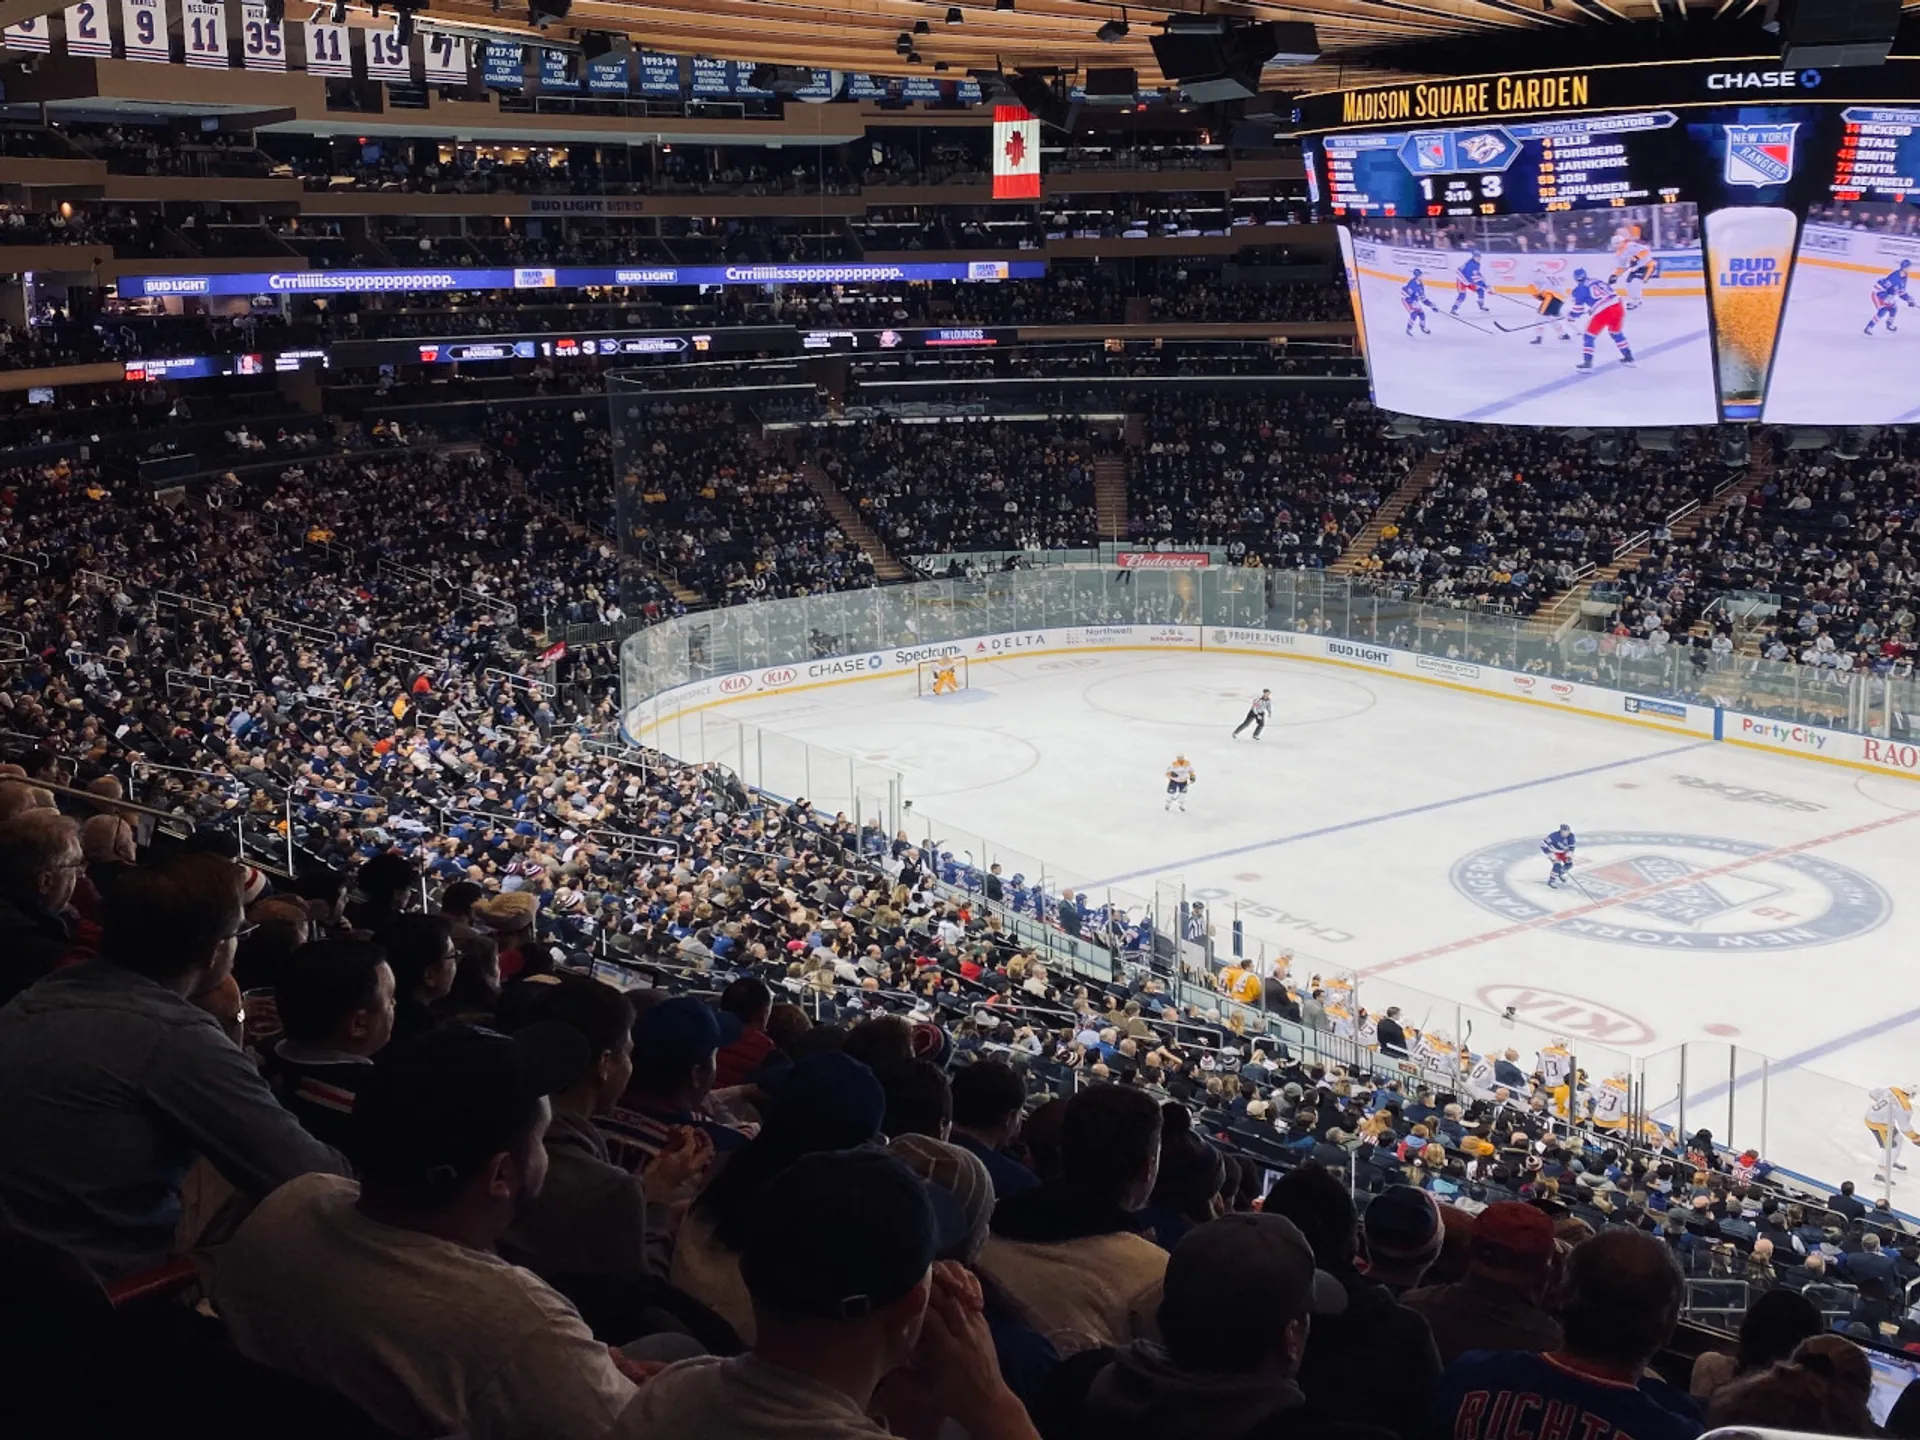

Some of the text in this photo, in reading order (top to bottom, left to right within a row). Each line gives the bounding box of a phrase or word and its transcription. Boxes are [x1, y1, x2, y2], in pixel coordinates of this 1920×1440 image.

[77, 3, 97, 38] 2
[137, 10, 154, 44] 9
[191, 17, 219, 52] 11
[246, 21, 281, 56] 35
[314, 29, 341, 60] 11
[372, 32, 403, 65] 19
[642, 56, 677, 66] 1993-94
[485, 74, 523, 83] CHAMPIONS
[590, 80, 628, 88] CHAMPIONS
[1707, 71, 1796, 89] CHASE
[642, 82, 679, 91] CHAMPIONS
[693, 84, 729, 92] CHAMPIONS
[1343, 75, 1588, 122] MADISON SQUARE GARDEN
[1872, 112, 1893, 121] NEW
[1532, 117, 1654, 135] NASHVILLE PREDATORS
[1542, 134, 1591, 147] 4 ELLIS
[1732, 132, 1789, 143] NEW YORK
[1858, 137, 1899, 148] STAAL
[1554, 144, 1625, 159] FORSBERG
[1856, 150, 1896, 161] SMITH
[1555, 157, 1629, 171] JARNKROK
[1740, 147, 1786, 179] RANGERS
[1854, 163, 1897, 173] CHYTIL
[1557, 172, 1587, 184] JOSI
[1834, 175, 1914, 187] 77 DEANGELO
[1420, 178, 1433, 200] 1
[1481, 175, 1502, 198] 3
[1558, 181, 1630, 196] JOHANSEN
[1444, 190, 1473, 202] 3:10
[1611, 198, 1625, 207] 12
[531, 201, 560, 211] BUD
[563, 201, 602, 211] LIGHT
[1428, 205, 1444, 216] 27
[1479, 203, 1496, 214] 13
[1729, 258, 1776, 272] BUD
[521, 270, 543, 278] BUD
[617, 271, 675, 281] BUD LIGHT
[1720, 272, 1782, 286] LIGHT
[146, 280, 206, 292] BUD LIGHT
[541, 342, 551, 356] 1
[582, 341, 596, 355] 3
[1123, 553, 1203, 568] Budweiser
[1086, 627, 1132, 636] Northwell
[992, 634, 1045, 650] DELTA
[895, 645, 957, 665] Spectrum
[1329, 643, 1389, 663] BUD LIGHT
[808, 658, 865, 678] CHASE
[767, 671, 792, 682] KIA
[724, 678, 747, 690] KIA
[1464, 856, 1539, 917] RANGERS
[1226, 898, 1355, 943] CHASE
[1571, 918, 1820, 947] NEW YORK
[1509, 990, 1635, 1038] KIA
[1545, 1060, 1558, 1077] 13
[1599, 1091, 1617, 1112] 23
